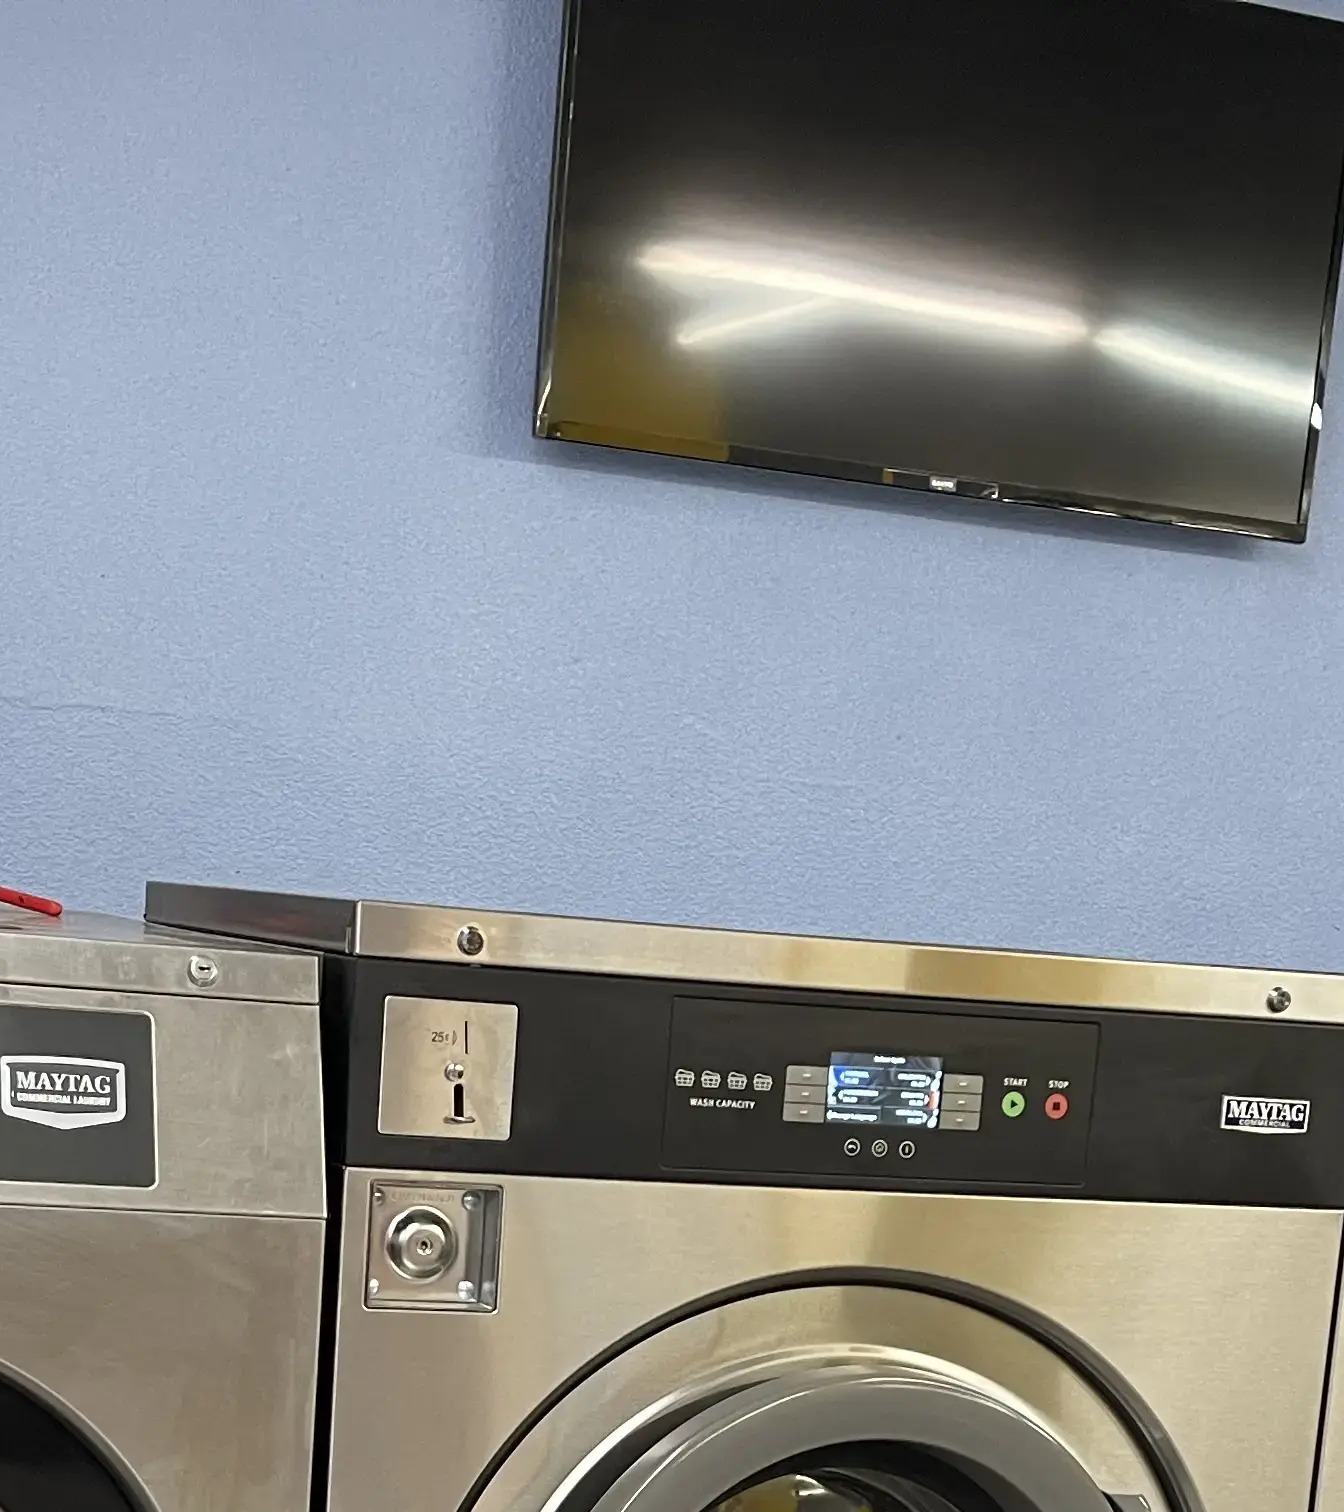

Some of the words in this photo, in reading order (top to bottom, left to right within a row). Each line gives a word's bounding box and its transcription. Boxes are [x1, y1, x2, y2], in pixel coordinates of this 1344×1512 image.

[16, 1070, 111, 1094] MAYTAG
[1003, 1077, 1028, 1087] START
[1048, 1080, 1070, 1089] STOP
[689, 1098, 715, 1107] WASH
[715, 1099, 756, 1110] CAPACITY
[1227, 1100, 1305, 1122] MAYTAG
